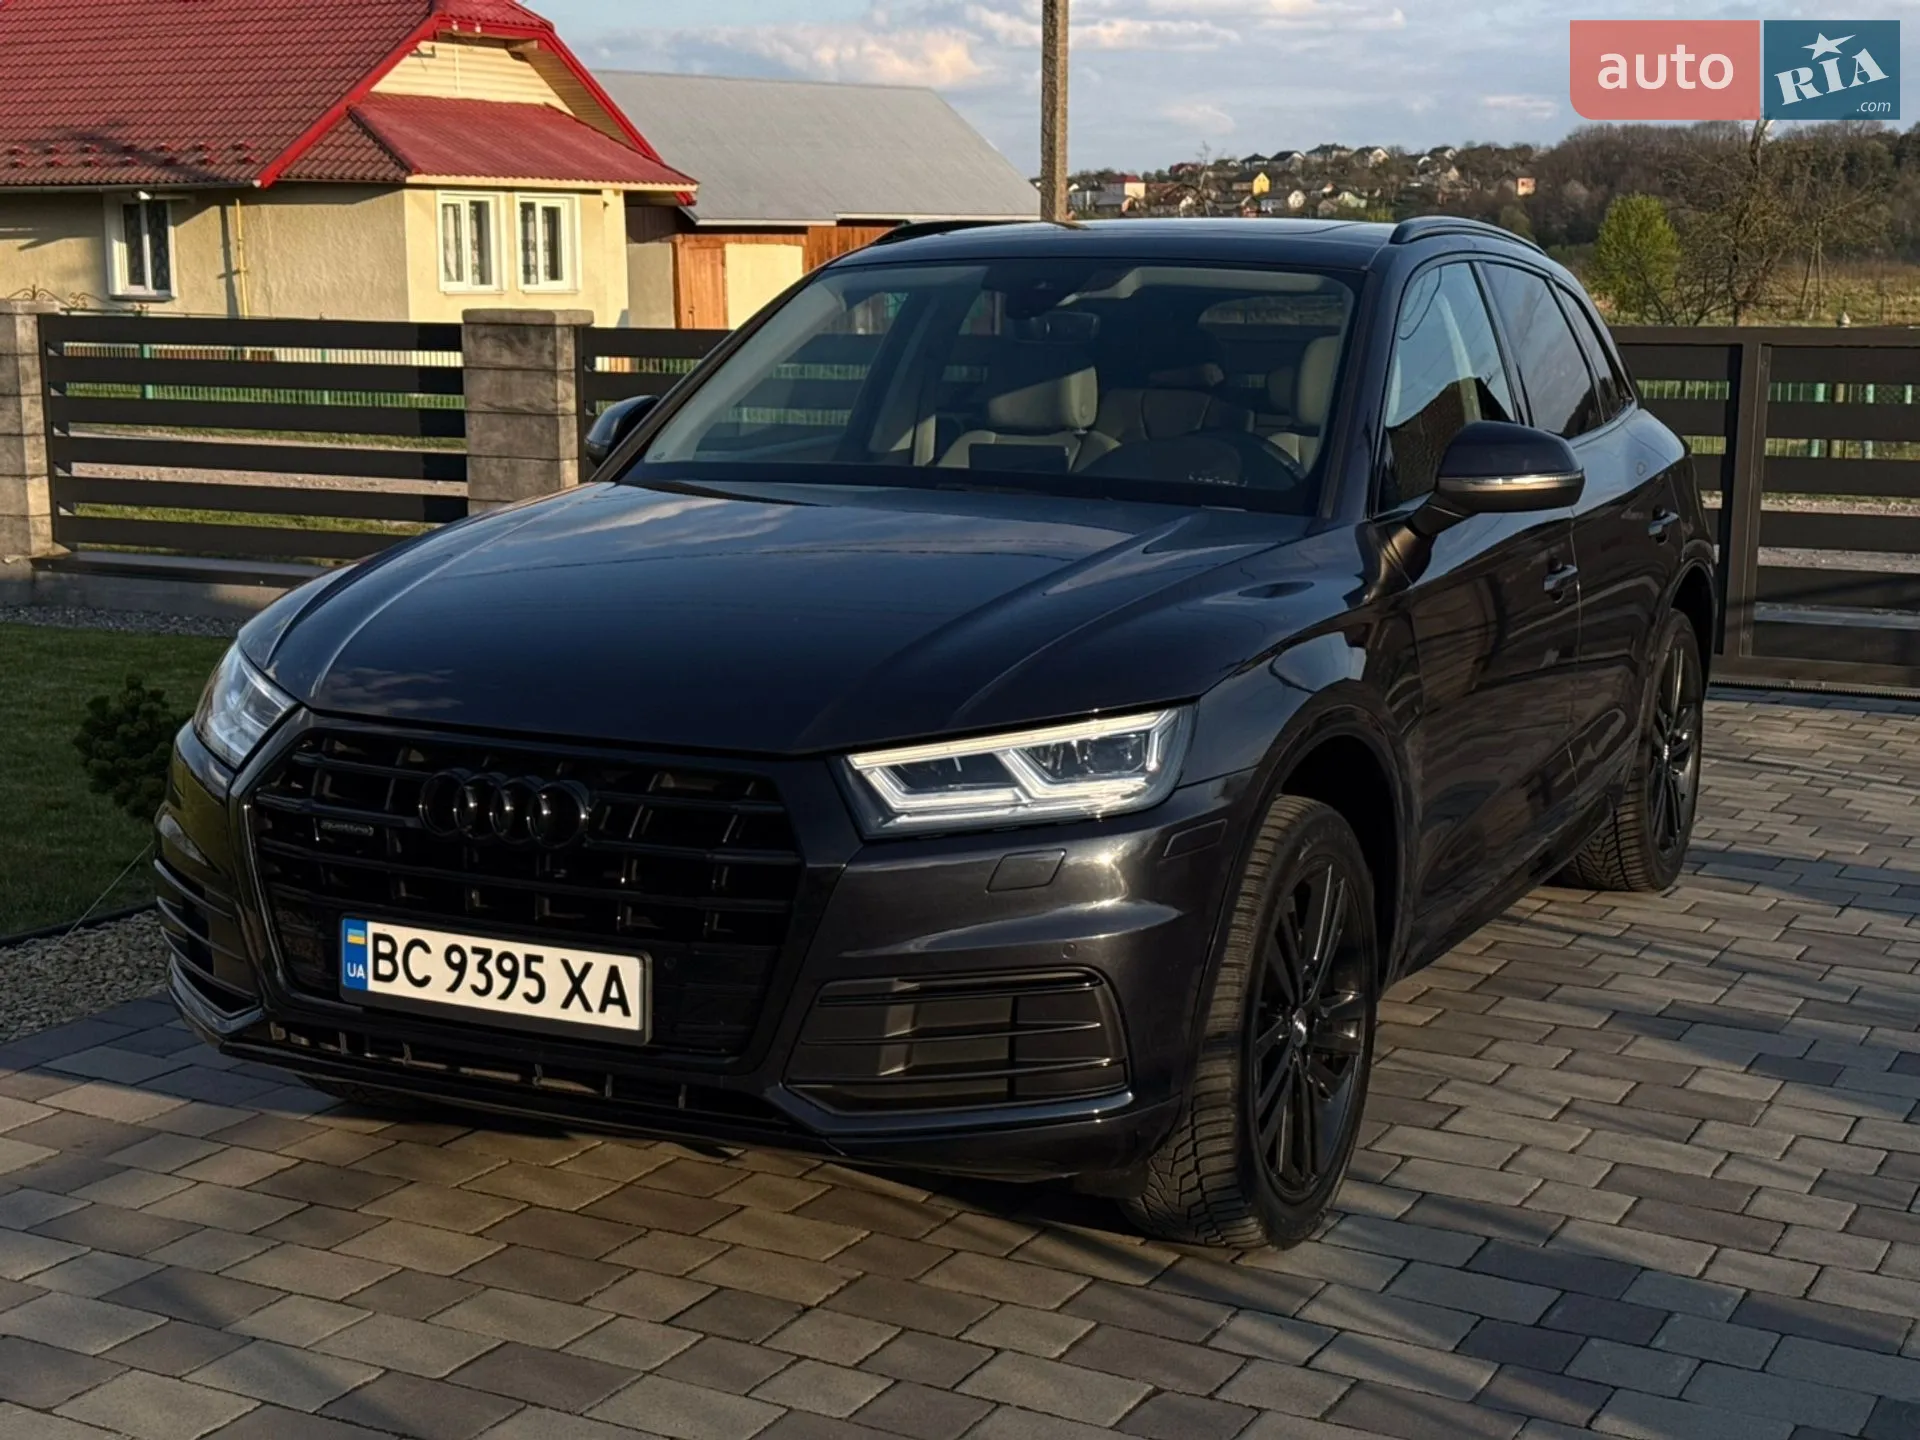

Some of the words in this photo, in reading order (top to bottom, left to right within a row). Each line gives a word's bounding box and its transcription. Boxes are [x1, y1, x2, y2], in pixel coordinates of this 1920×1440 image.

[347, 962, 366, 980] UA
[372, 932, 432, 988] BC
[444, 943, 547, 1005] 9395
[560, 957, 632, 1018] XA
